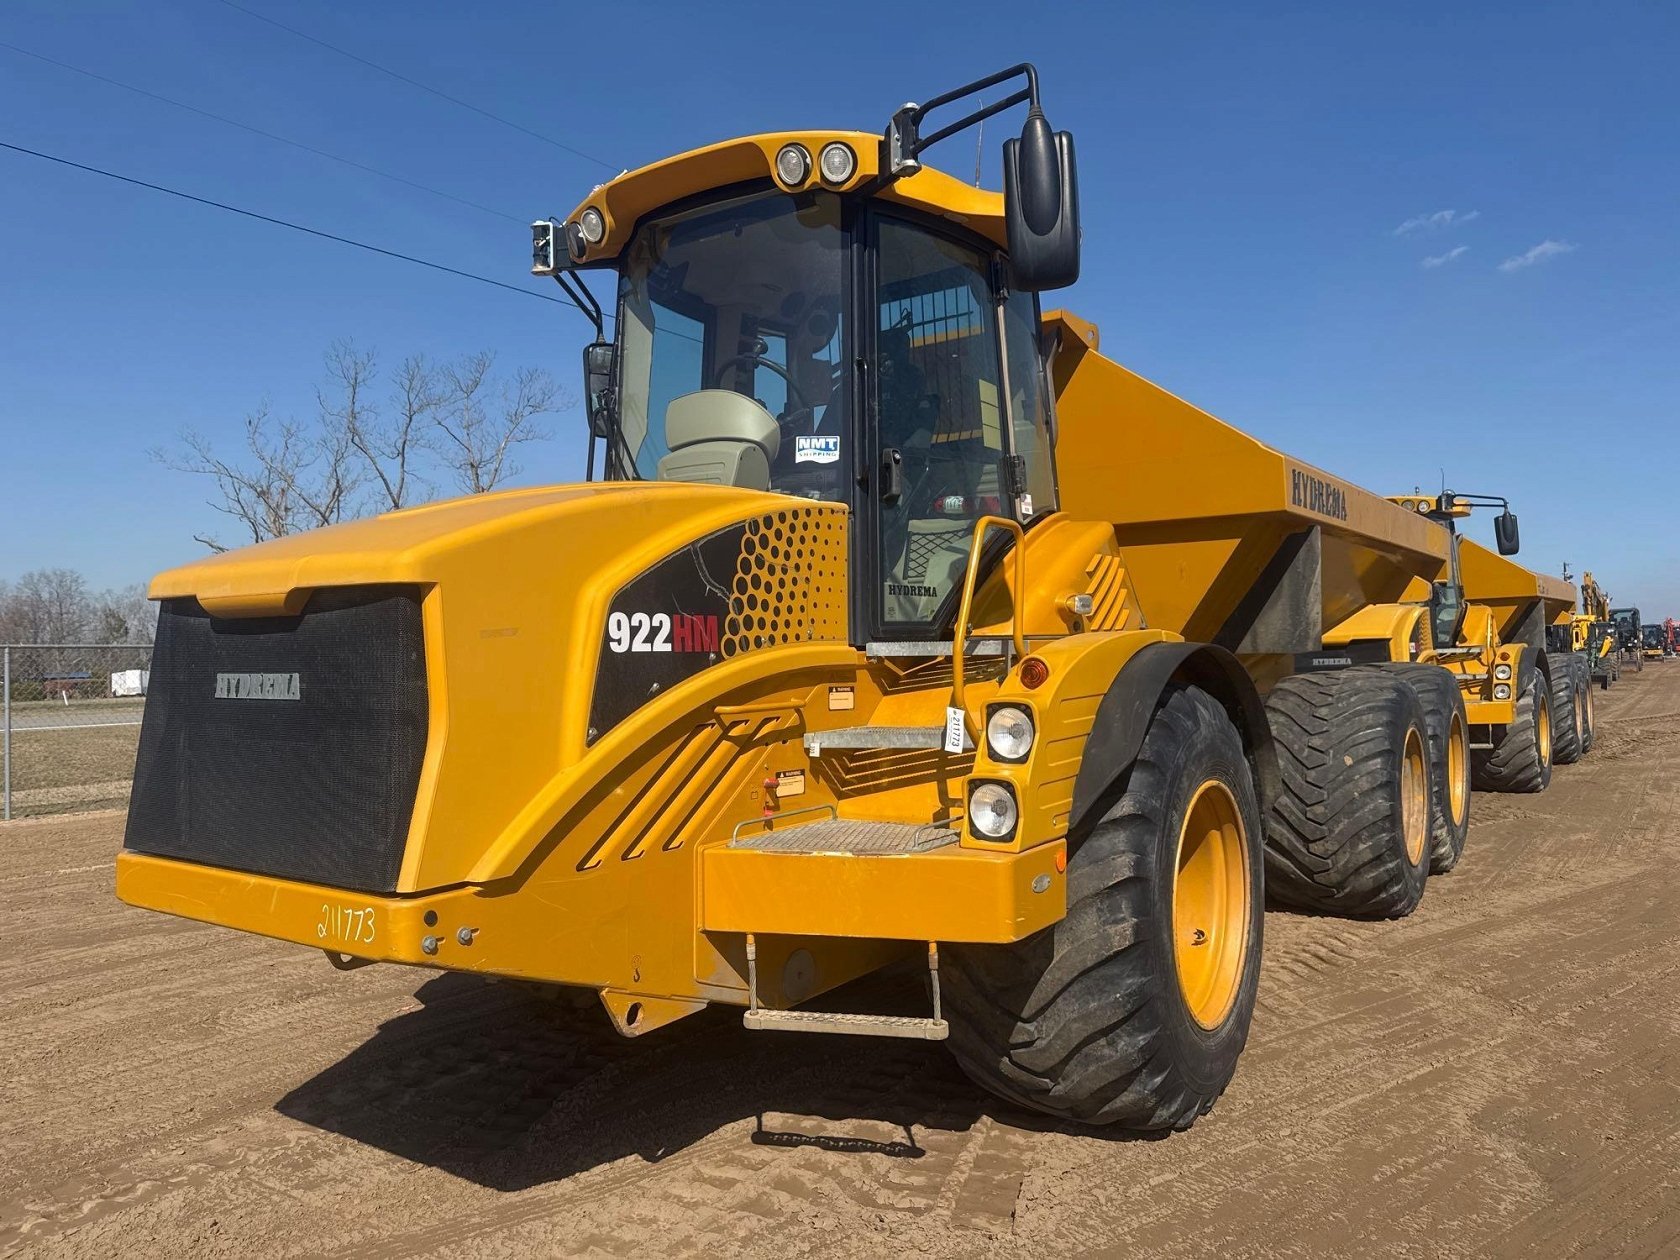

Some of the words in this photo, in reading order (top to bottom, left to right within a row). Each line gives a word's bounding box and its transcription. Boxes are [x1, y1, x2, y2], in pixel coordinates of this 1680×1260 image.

[799, 438, 837, 450] NMT
[1292, 469, 1347, 521] HYDREMA
[888, 584, 937, 597] HYDREMA
[608, 611, 719, 653] 922HM
[215, 672, 301, 700] HYDREMA
[952, 716, 961, 748] 211773
[317, 904, 375, 943] 211773
